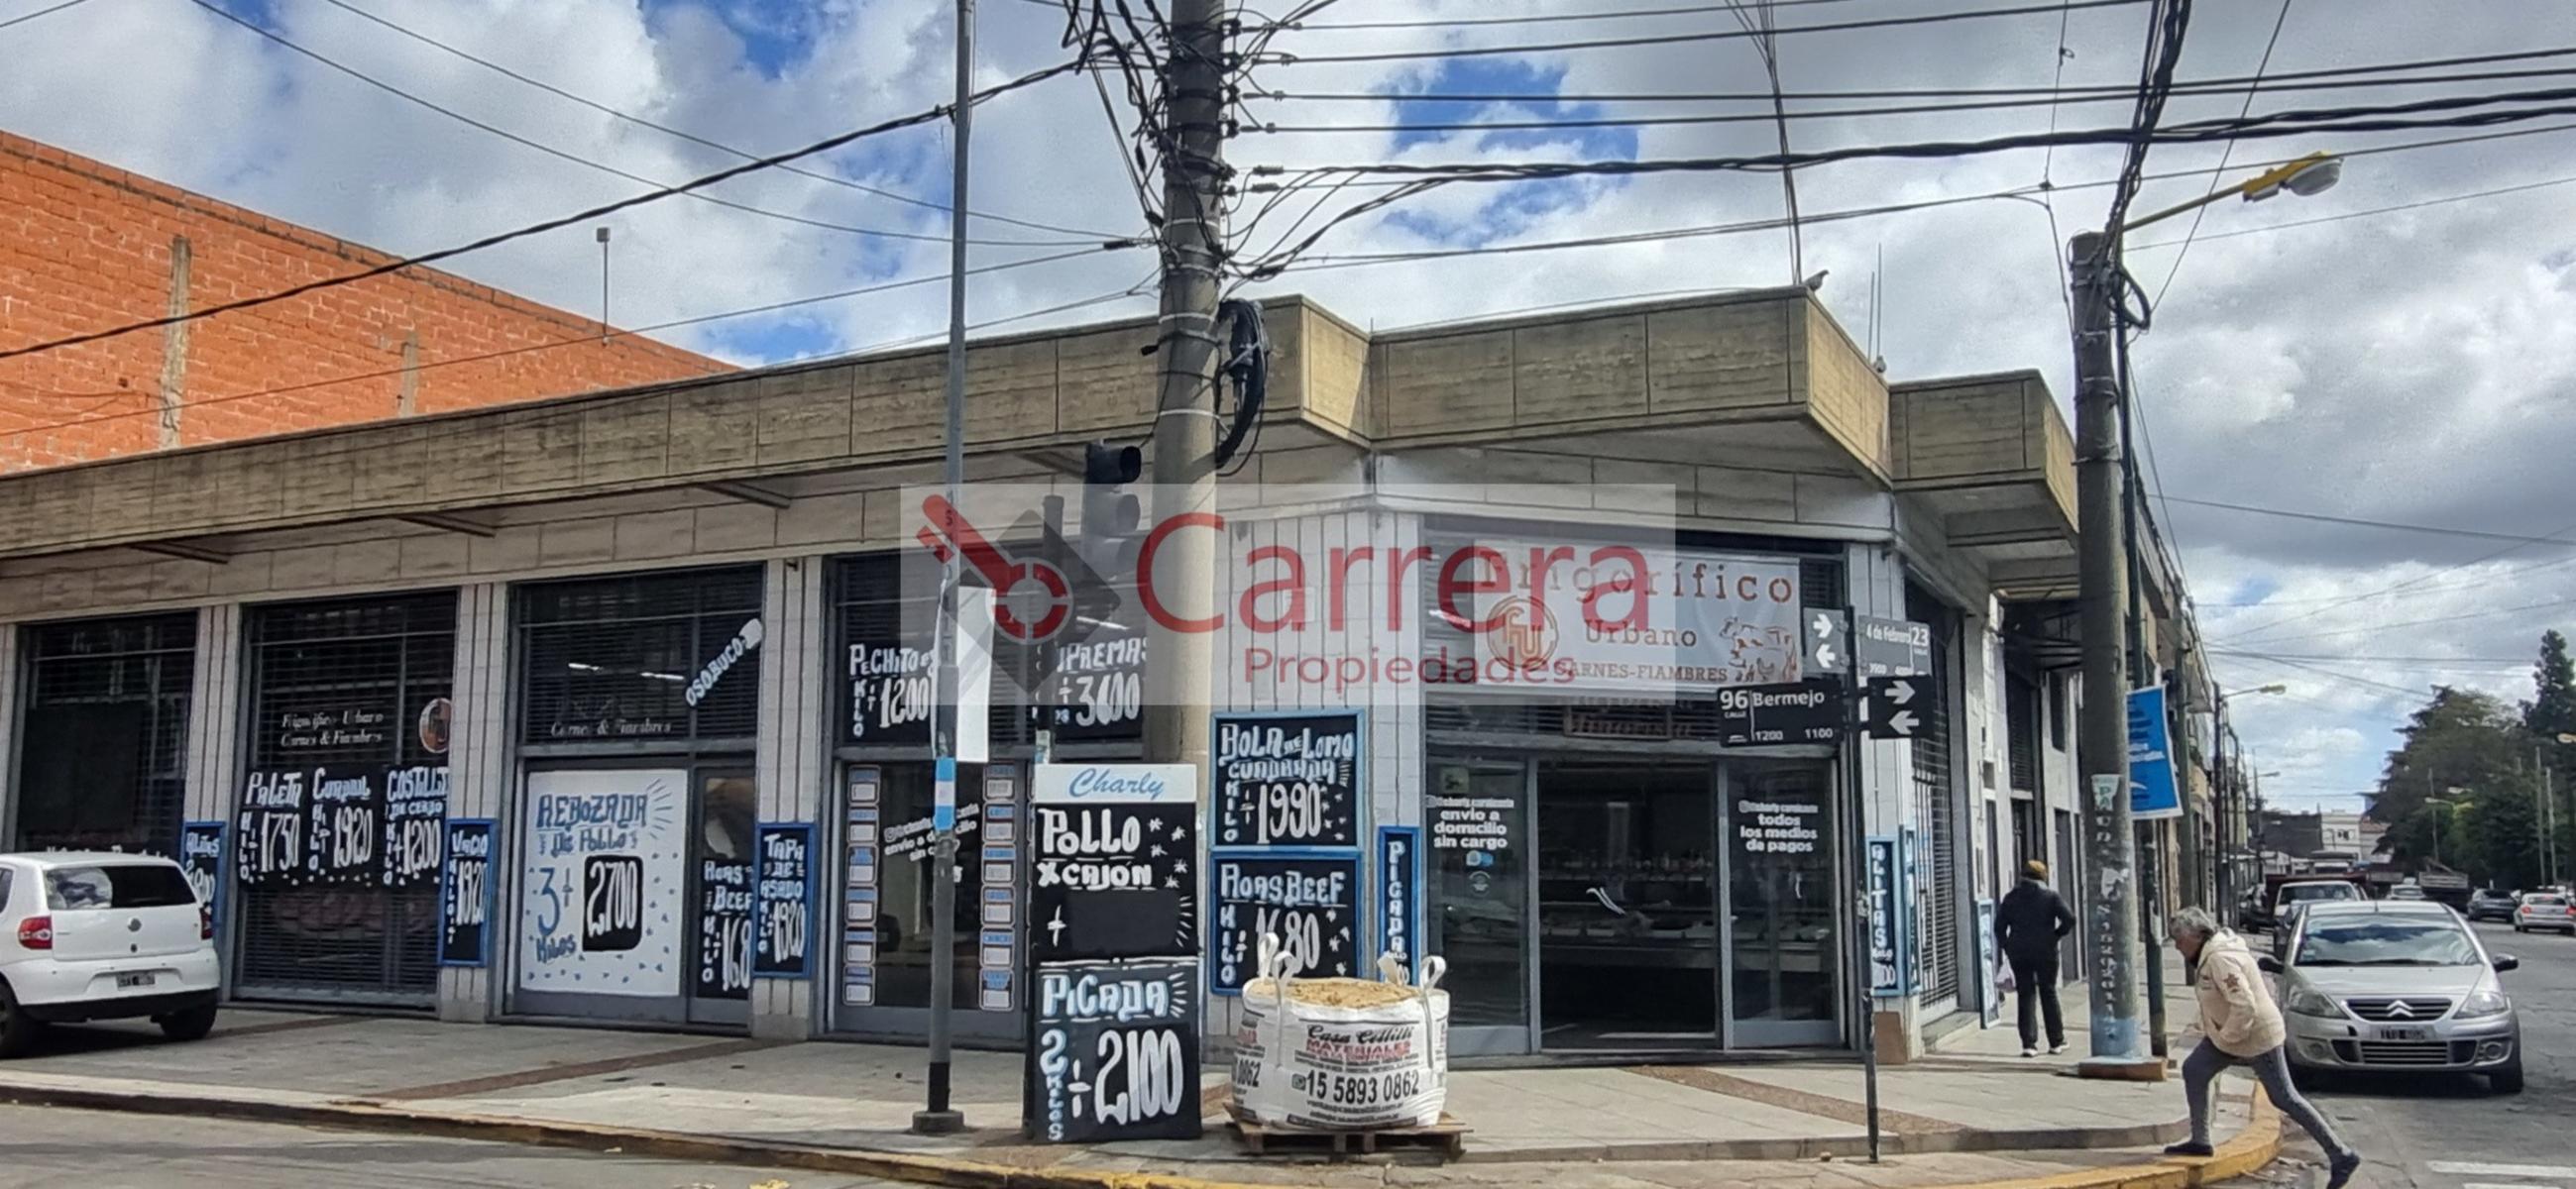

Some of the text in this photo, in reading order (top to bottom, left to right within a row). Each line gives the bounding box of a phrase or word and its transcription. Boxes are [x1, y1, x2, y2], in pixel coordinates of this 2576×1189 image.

[1585, 618, 1697, 647] Urbano
[1912, 625, 1929, 646] 23
[686, 637, 743, 706] OSOBUCO
[1558, 660, 1729, 683] CARNES-FIAMBRES
[853, 679, 867, 737] KILO
[879, 678, 929, 728] 1200
[1075, 672, 1140, 726] 3600
[1720, 690, 1748, 710] 96
[1752, 689, 1825, 708] Bermejo
[1805, 728, 1833, 739] 1100
[1068, 767, 1165, 801] Charly
[1038, 808, 1141, 855] POLLO
[1224, 780, 1239, 842] KILO
[1257, 782, 1321, 844] 1990
[1740, 824, 1818, 840] los medios
[1757, 813, 1801, 826] todos
[261, 811, 300, 873] 1750
[308, 804, 324, 871] KILO
[333, 806, 374, 869] 1920
[383, 823, 396, 886] KILO
[403, 818, 441, 875] 1200
[1433, 835, 1509, 850] sin cargo
[1767, 841, 1813, 853] pagos
[537, 866, 561, 937] 3
[586, 860, 638, 938] 2700
[702, 916, 716, 983] KILO
[723, 917, 752, 992] 168
[1219, 904, 1236, 985] KILO
[1041, 974, 1169, 1023] PICADA
[1039, 1028, 1068, 1076] 2
[1306, 1025, 1352, 1044] Casa
[1093, 1028, 1183, 1126] 2100
[1306, 1069, 1419, 1105] 15 5893 0862
